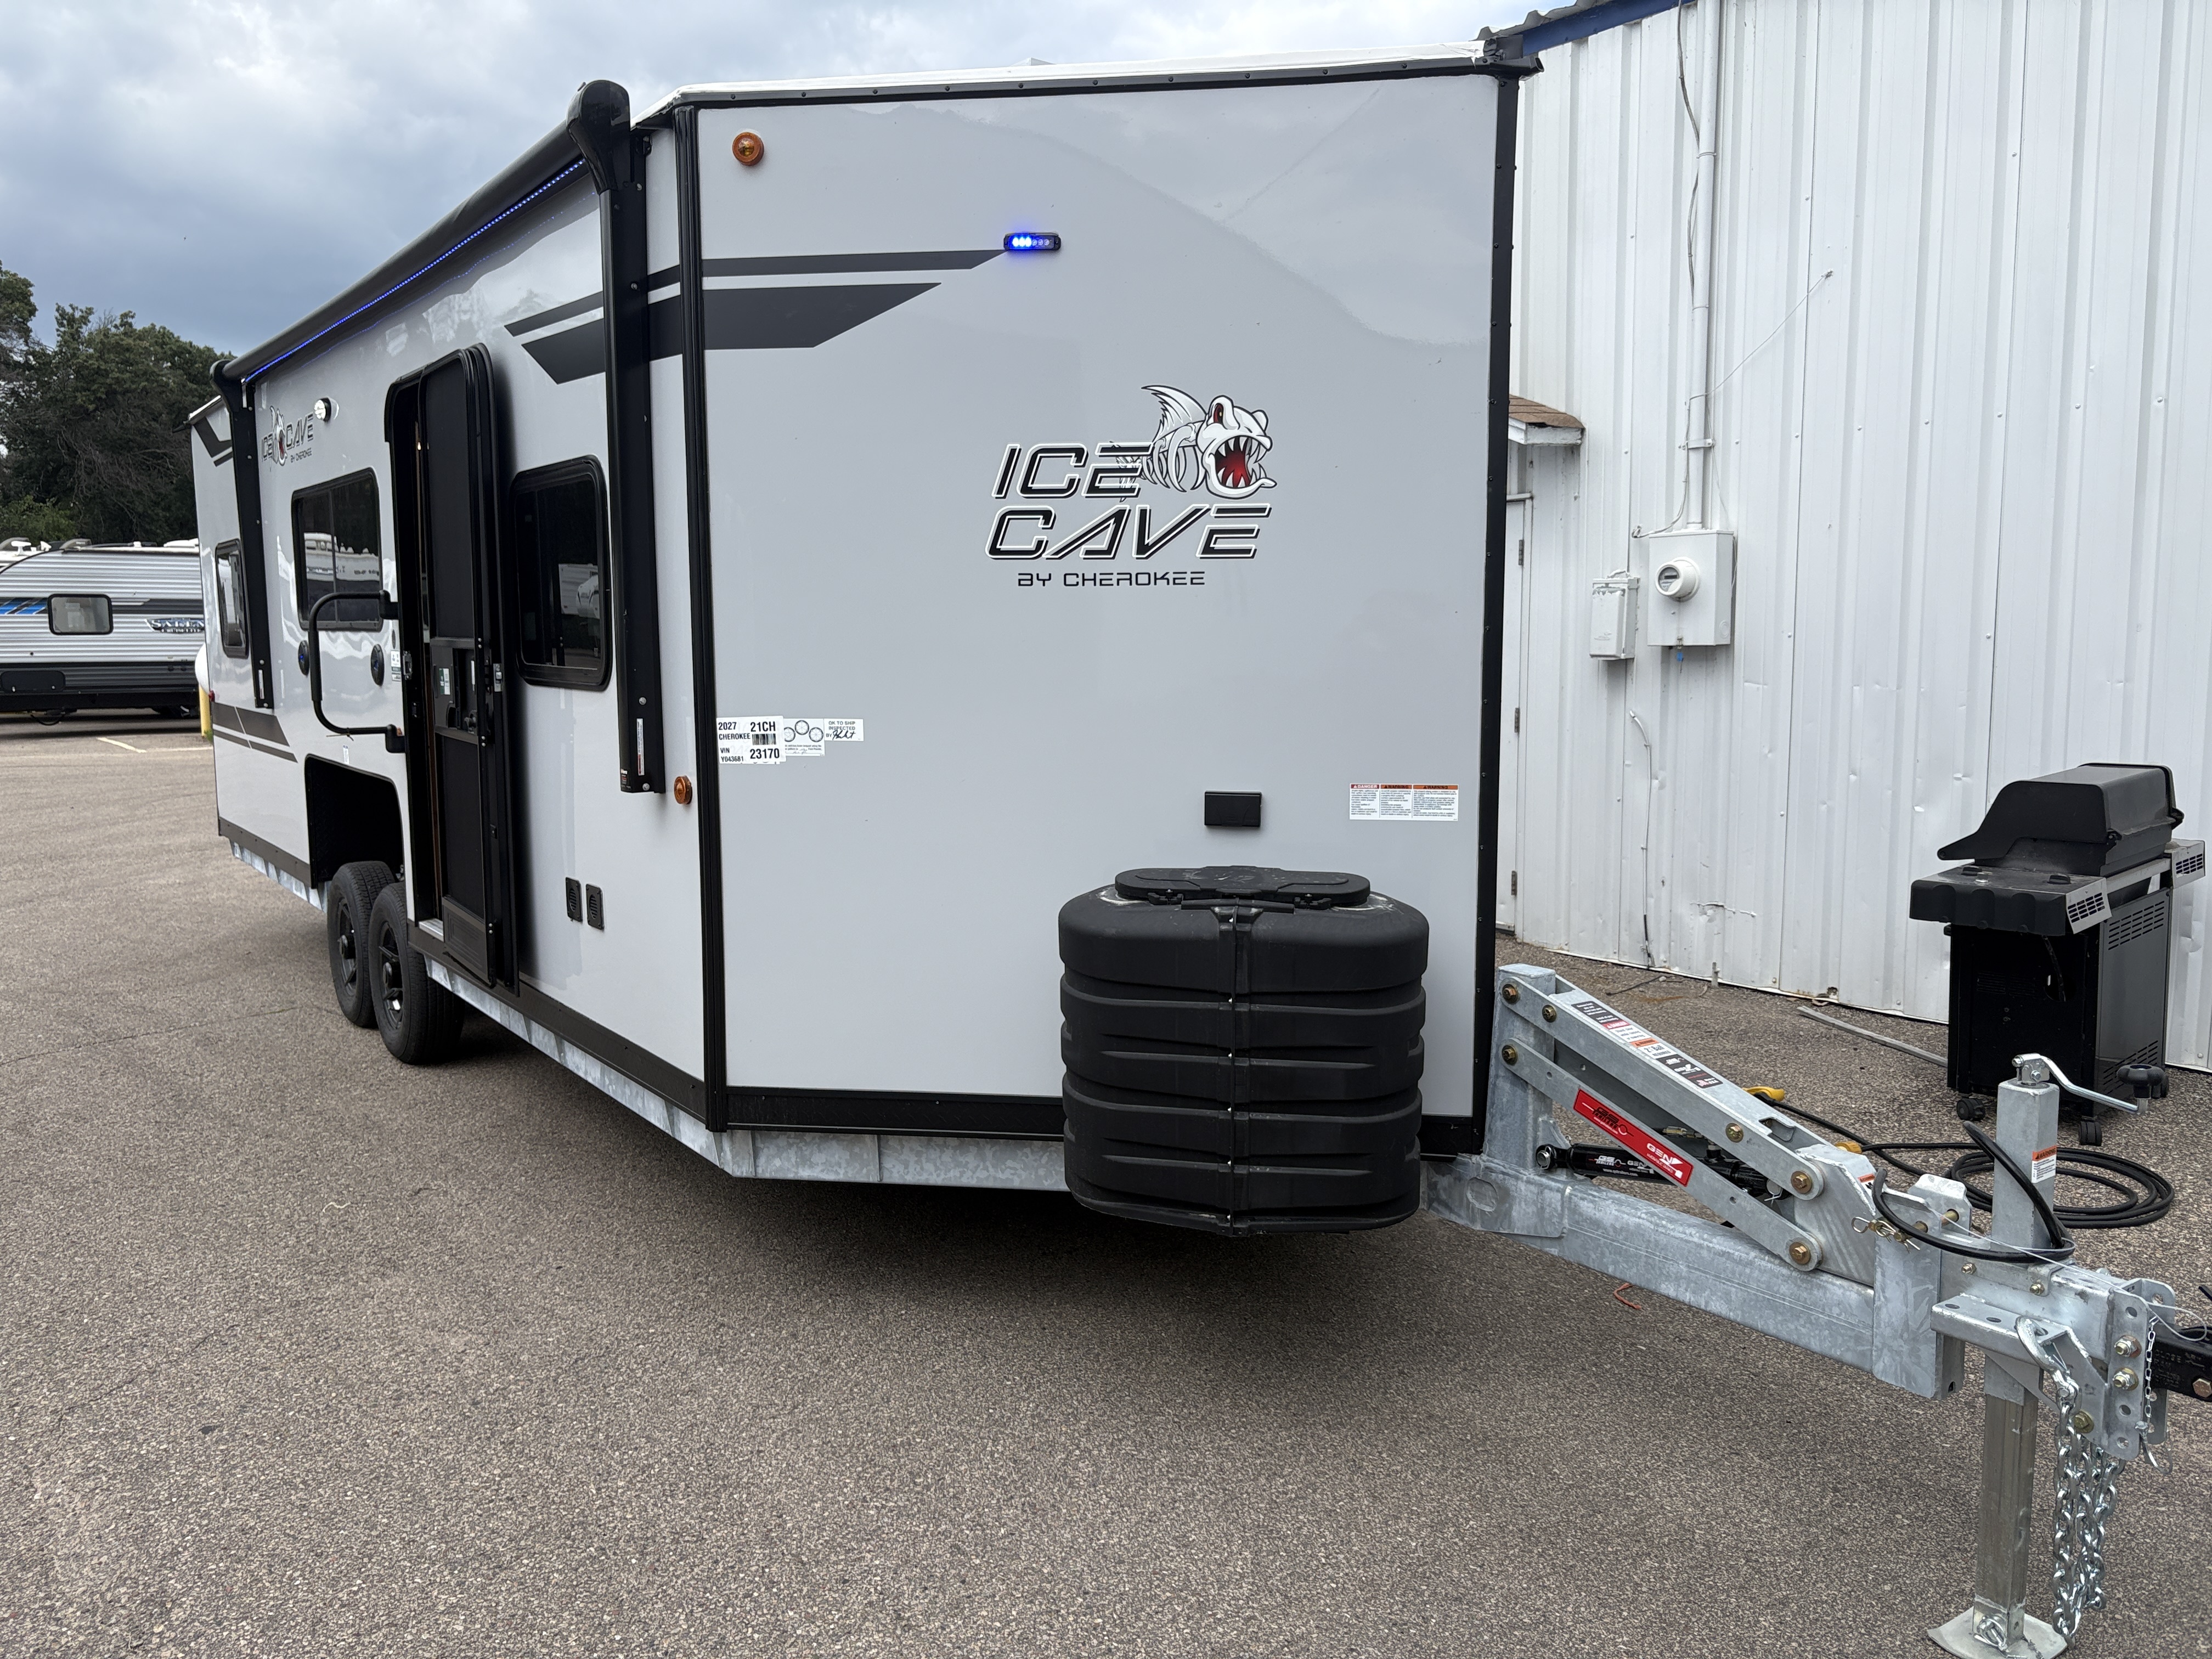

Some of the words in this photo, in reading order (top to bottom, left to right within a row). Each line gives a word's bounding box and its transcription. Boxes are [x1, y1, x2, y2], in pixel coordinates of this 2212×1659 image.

[285, 411, 314, 451] CAVE
[991, 442, 1154, 499] ICE
[985, 503, 1272, 560] CAVE
[1018, 573, 1052, 586] BY
[1063, 571, 1206, 586] CHEROKEE
[718, 721, 737, 730] 2027
[750, 721, 776, 732] 21CH
[750, 748, 780, 759] 23170
